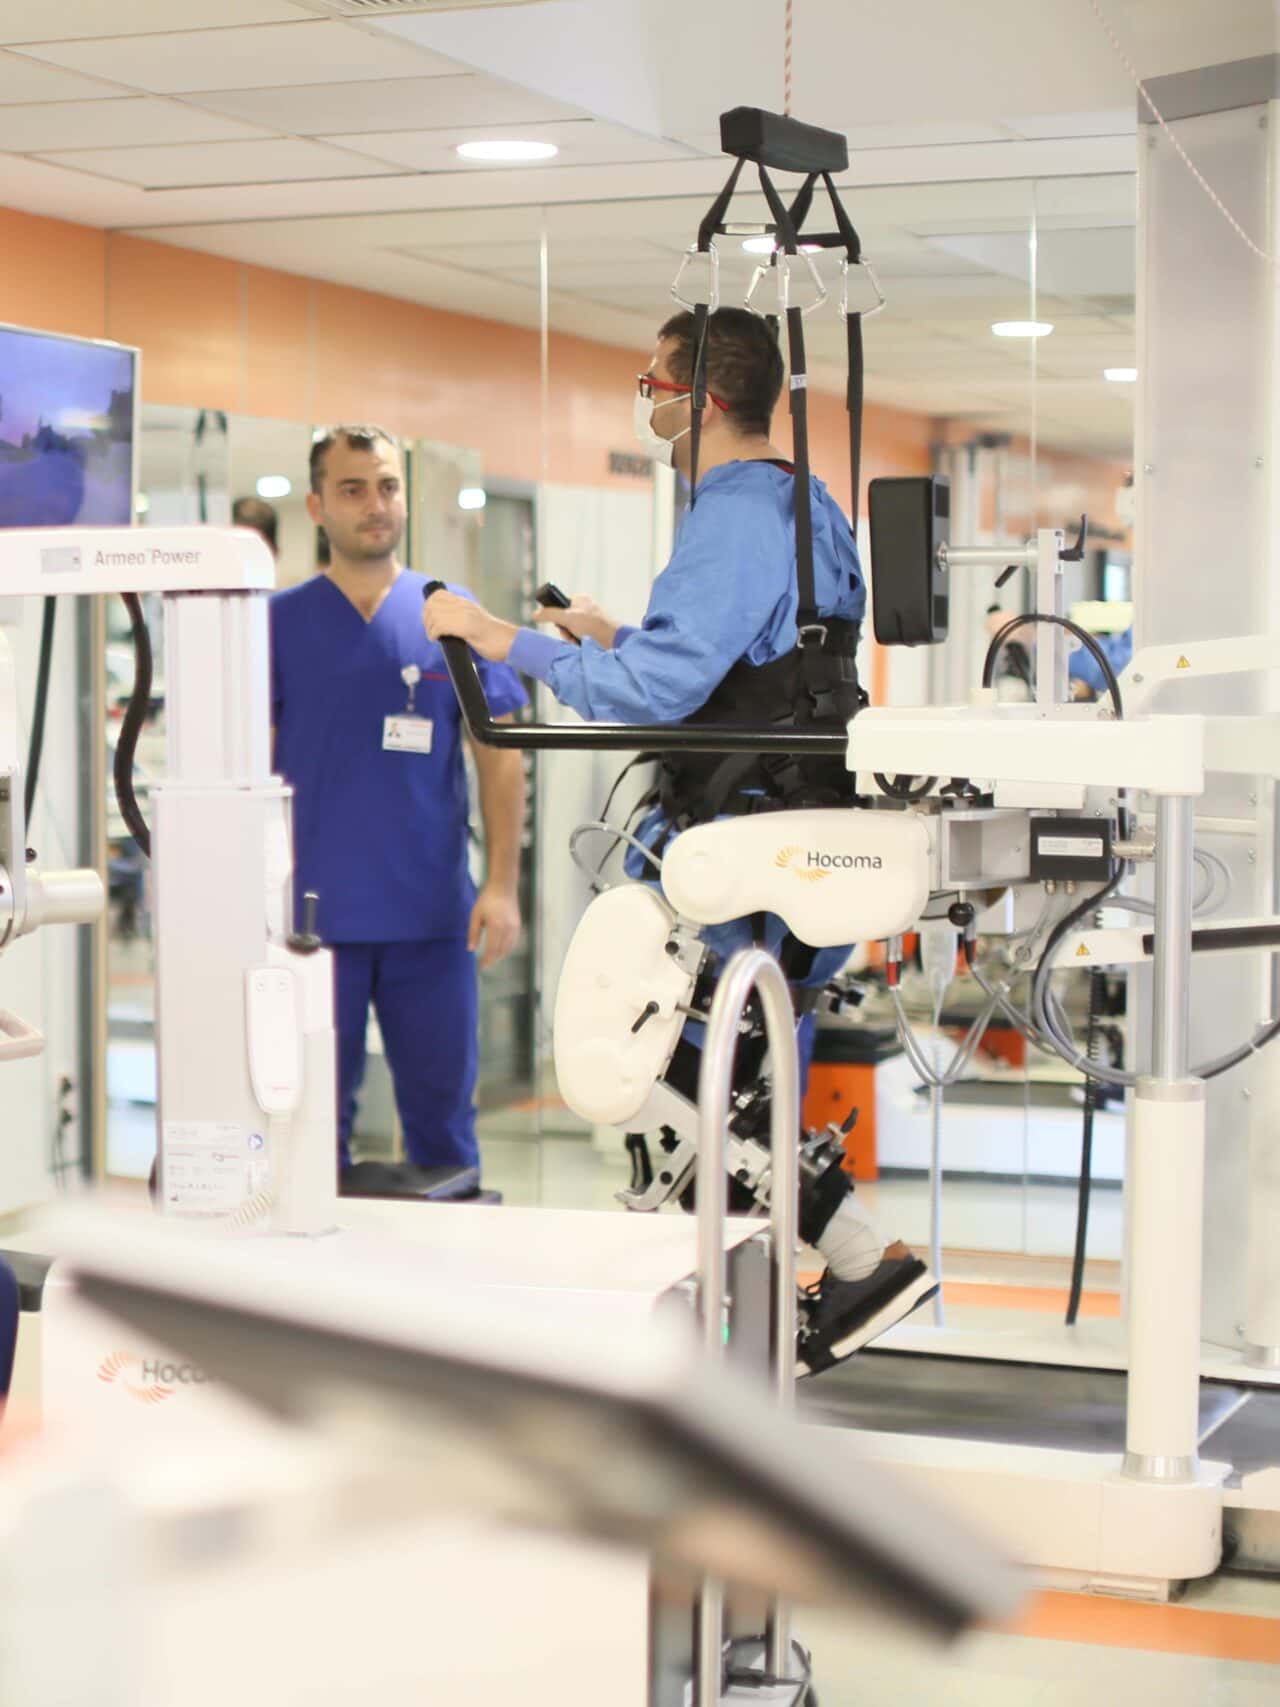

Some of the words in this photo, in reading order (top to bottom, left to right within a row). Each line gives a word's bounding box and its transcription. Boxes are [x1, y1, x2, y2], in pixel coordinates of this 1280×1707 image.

[94, 550, 146, 567] Armeo
[151, 548, 202, 565] Power
[806, 850, 883, 869] Hocoma
[141, 1359, 207, 1384] Hoco
